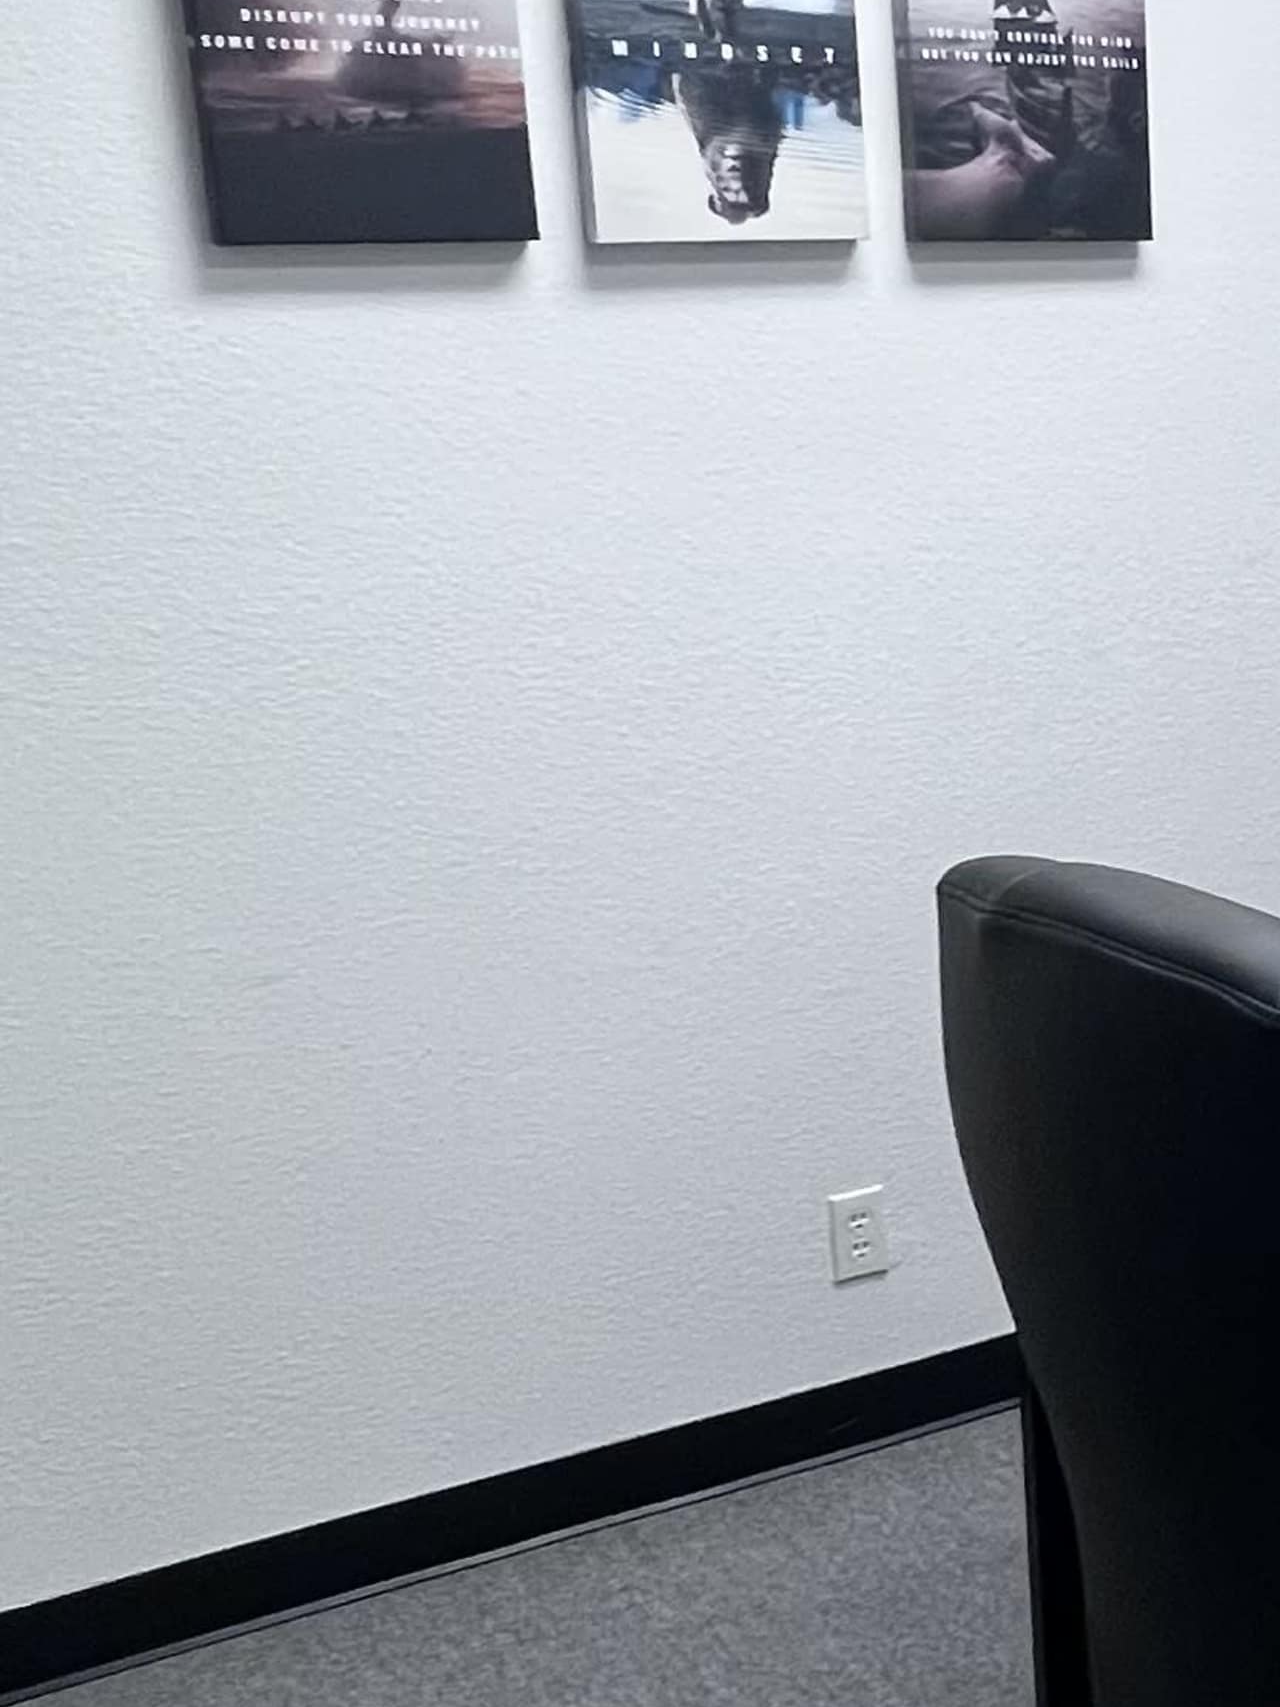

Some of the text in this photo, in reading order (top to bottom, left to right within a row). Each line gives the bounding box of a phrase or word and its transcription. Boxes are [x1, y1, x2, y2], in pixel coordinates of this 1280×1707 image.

[239, 7, 325, 24] DISRUPT
[200, 34, 255, 50] SOME
[265, 36, 320, 52] COME
[362, 40, 423, 56] CLEAR
[611, 39, 836, 64] MINDSET
